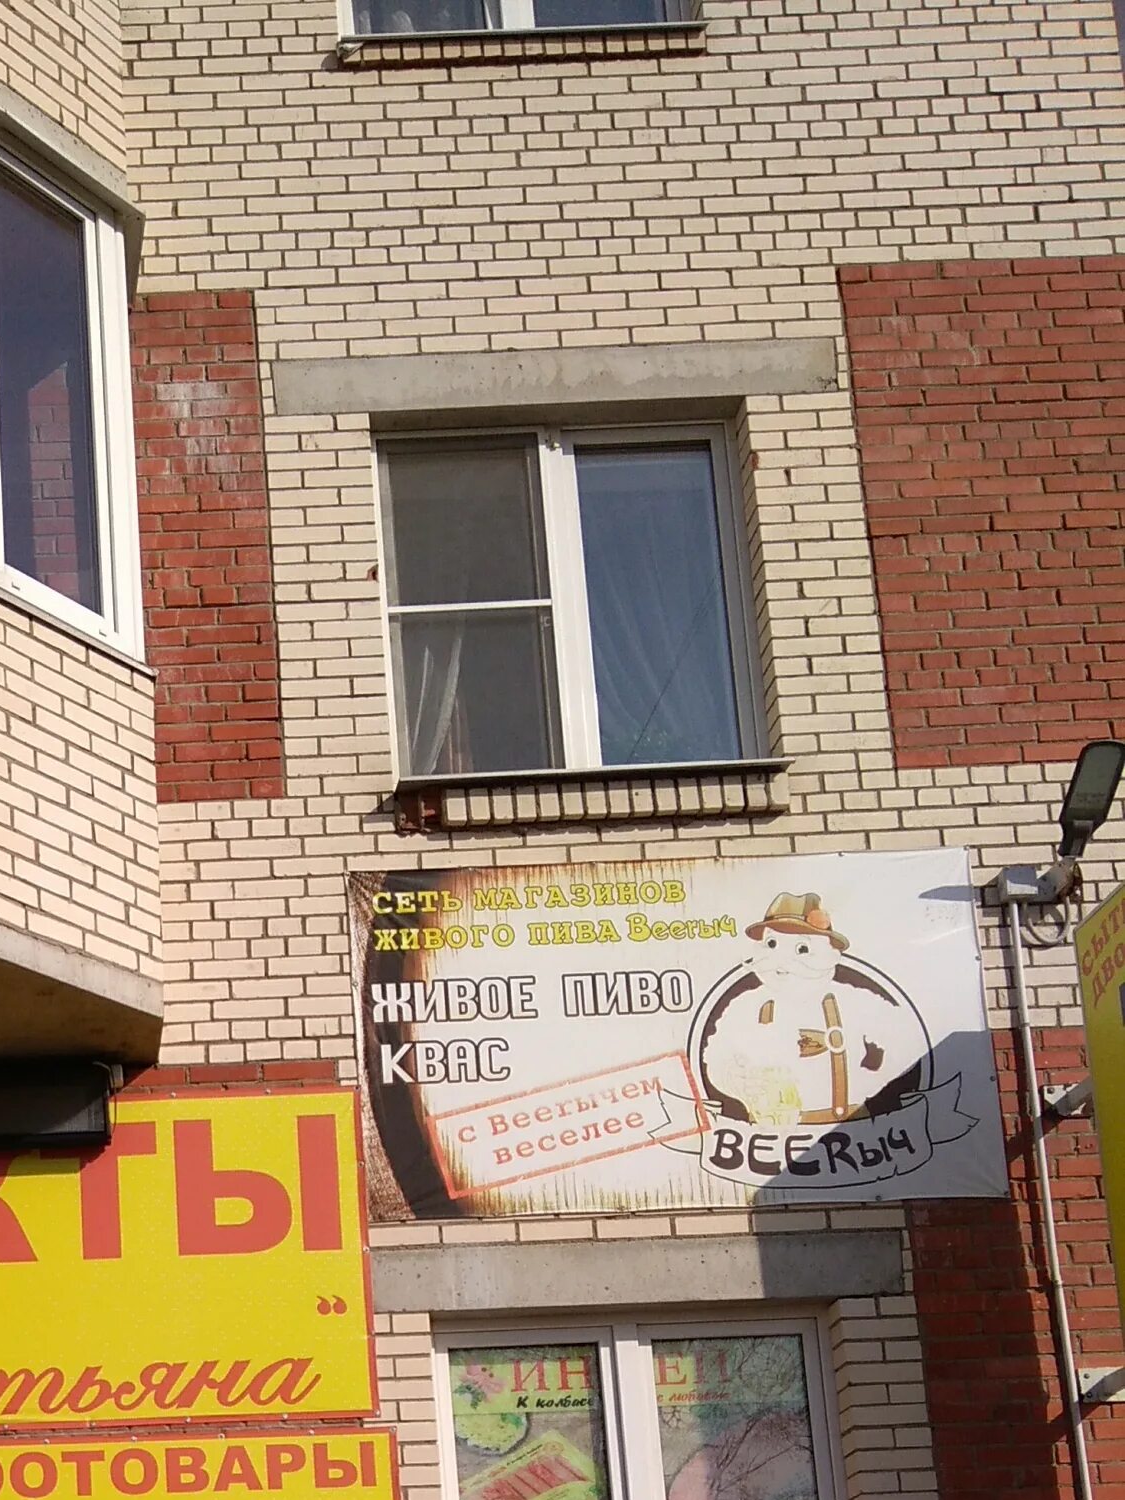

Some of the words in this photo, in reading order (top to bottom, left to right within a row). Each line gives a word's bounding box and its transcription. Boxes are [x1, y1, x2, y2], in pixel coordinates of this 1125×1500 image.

[373, 890, 463, 915] СЕТЬ
[474, 880, 686, 911] МАГАЗИНОВ
[374, 923, 515, 952] ЖИВОГО
[527, 919, 621, 945] ПИВА
[1082, 896, 1125, 976] СЫТ
[371, 975, 538, 1023] ЖИВОЕ
[562, 969, 695, 1017] ПИВО
[1092, 942, 1125, 1008] ДВО
[381, 1037, 511, 1084] КВАС
[458, 1124, 477, 1143] с
[493, 1110, 645, 1165] веселее
